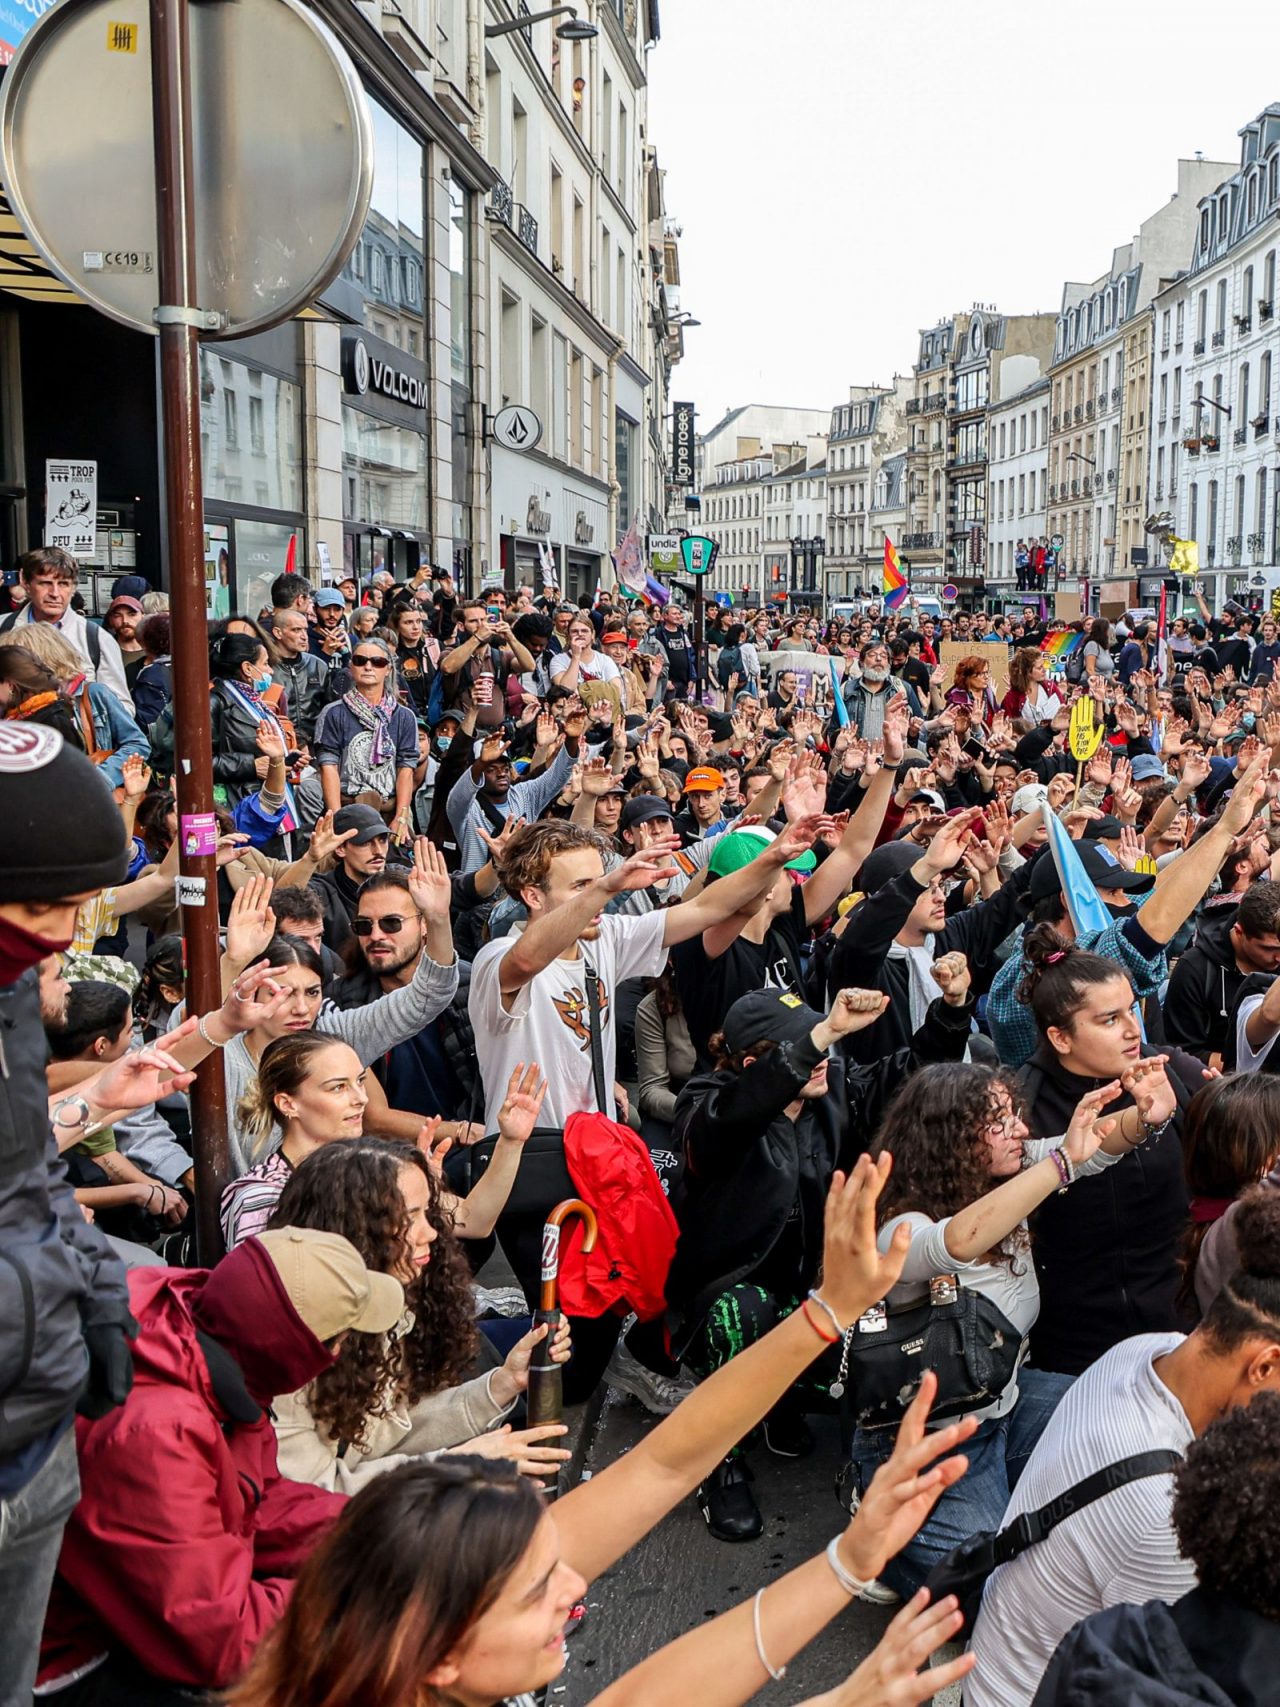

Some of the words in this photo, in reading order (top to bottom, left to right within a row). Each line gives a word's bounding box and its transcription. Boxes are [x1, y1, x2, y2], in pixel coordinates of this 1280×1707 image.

[123, 252, 138, 265] 19
[372, 358, 428, 409] VOLCOM
[70, 465, 95, 477] TROP
[675, 448, 692, 482] ligne
[52, 535, 70, 547] PEU
[651, 539, 678, 549] undiz
[901, 1338, 924, 1352] GUESS
